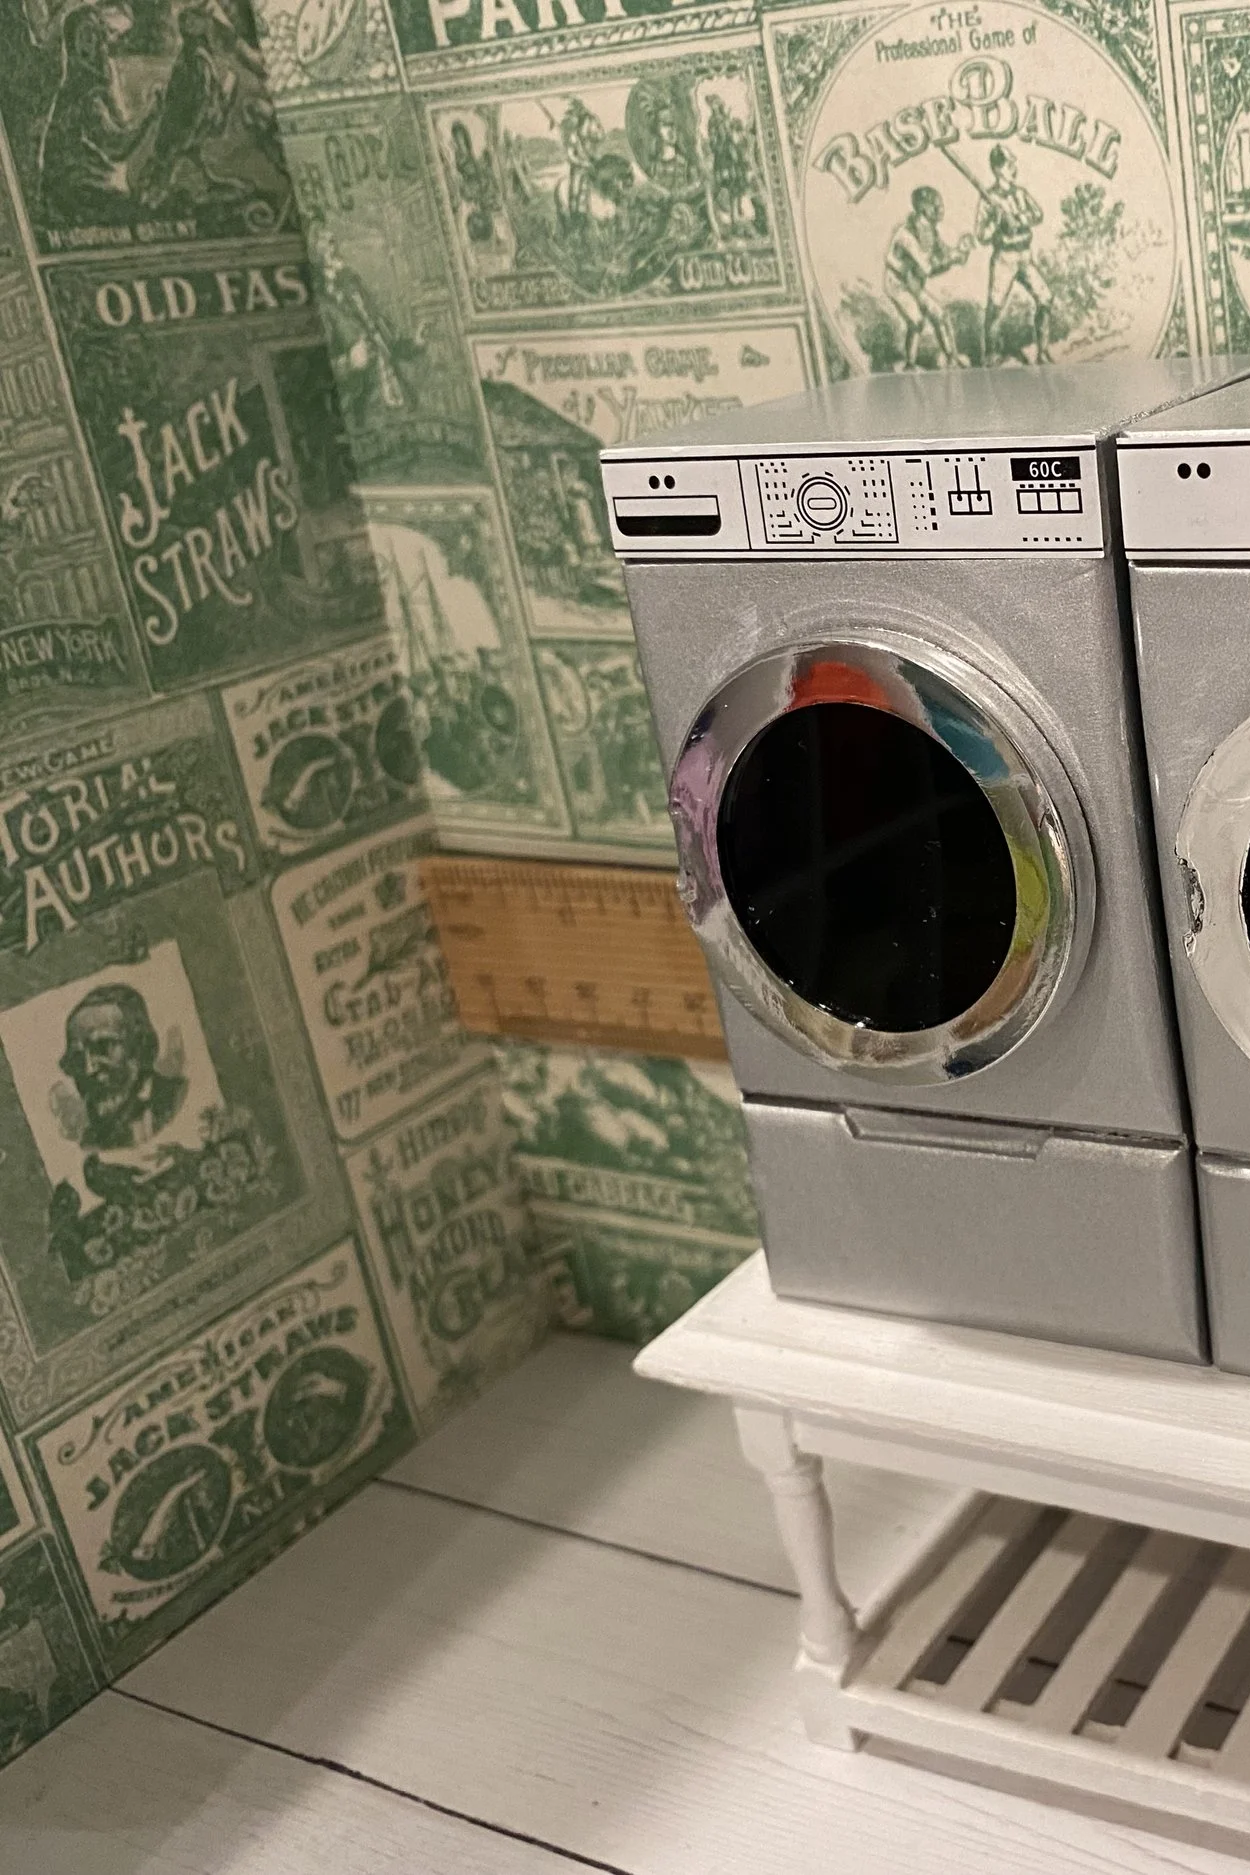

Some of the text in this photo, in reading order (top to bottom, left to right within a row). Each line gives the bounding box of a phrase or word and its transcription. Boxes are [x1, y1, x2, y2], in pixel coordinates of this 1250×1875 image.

[875, 22, 1037, 63] Professional Game of
[812, 54, 1122, 204] BASE BALL
[96, 276, 197, 327] OLD
[118, 377, 249, 548] JACK
[1028, 460, 1063, 478] 60C
[133, 457, 300, 646] STRAWS
[0, 628, 54, 671] NEW
[24, 811, 247, 952] AUTHORS
